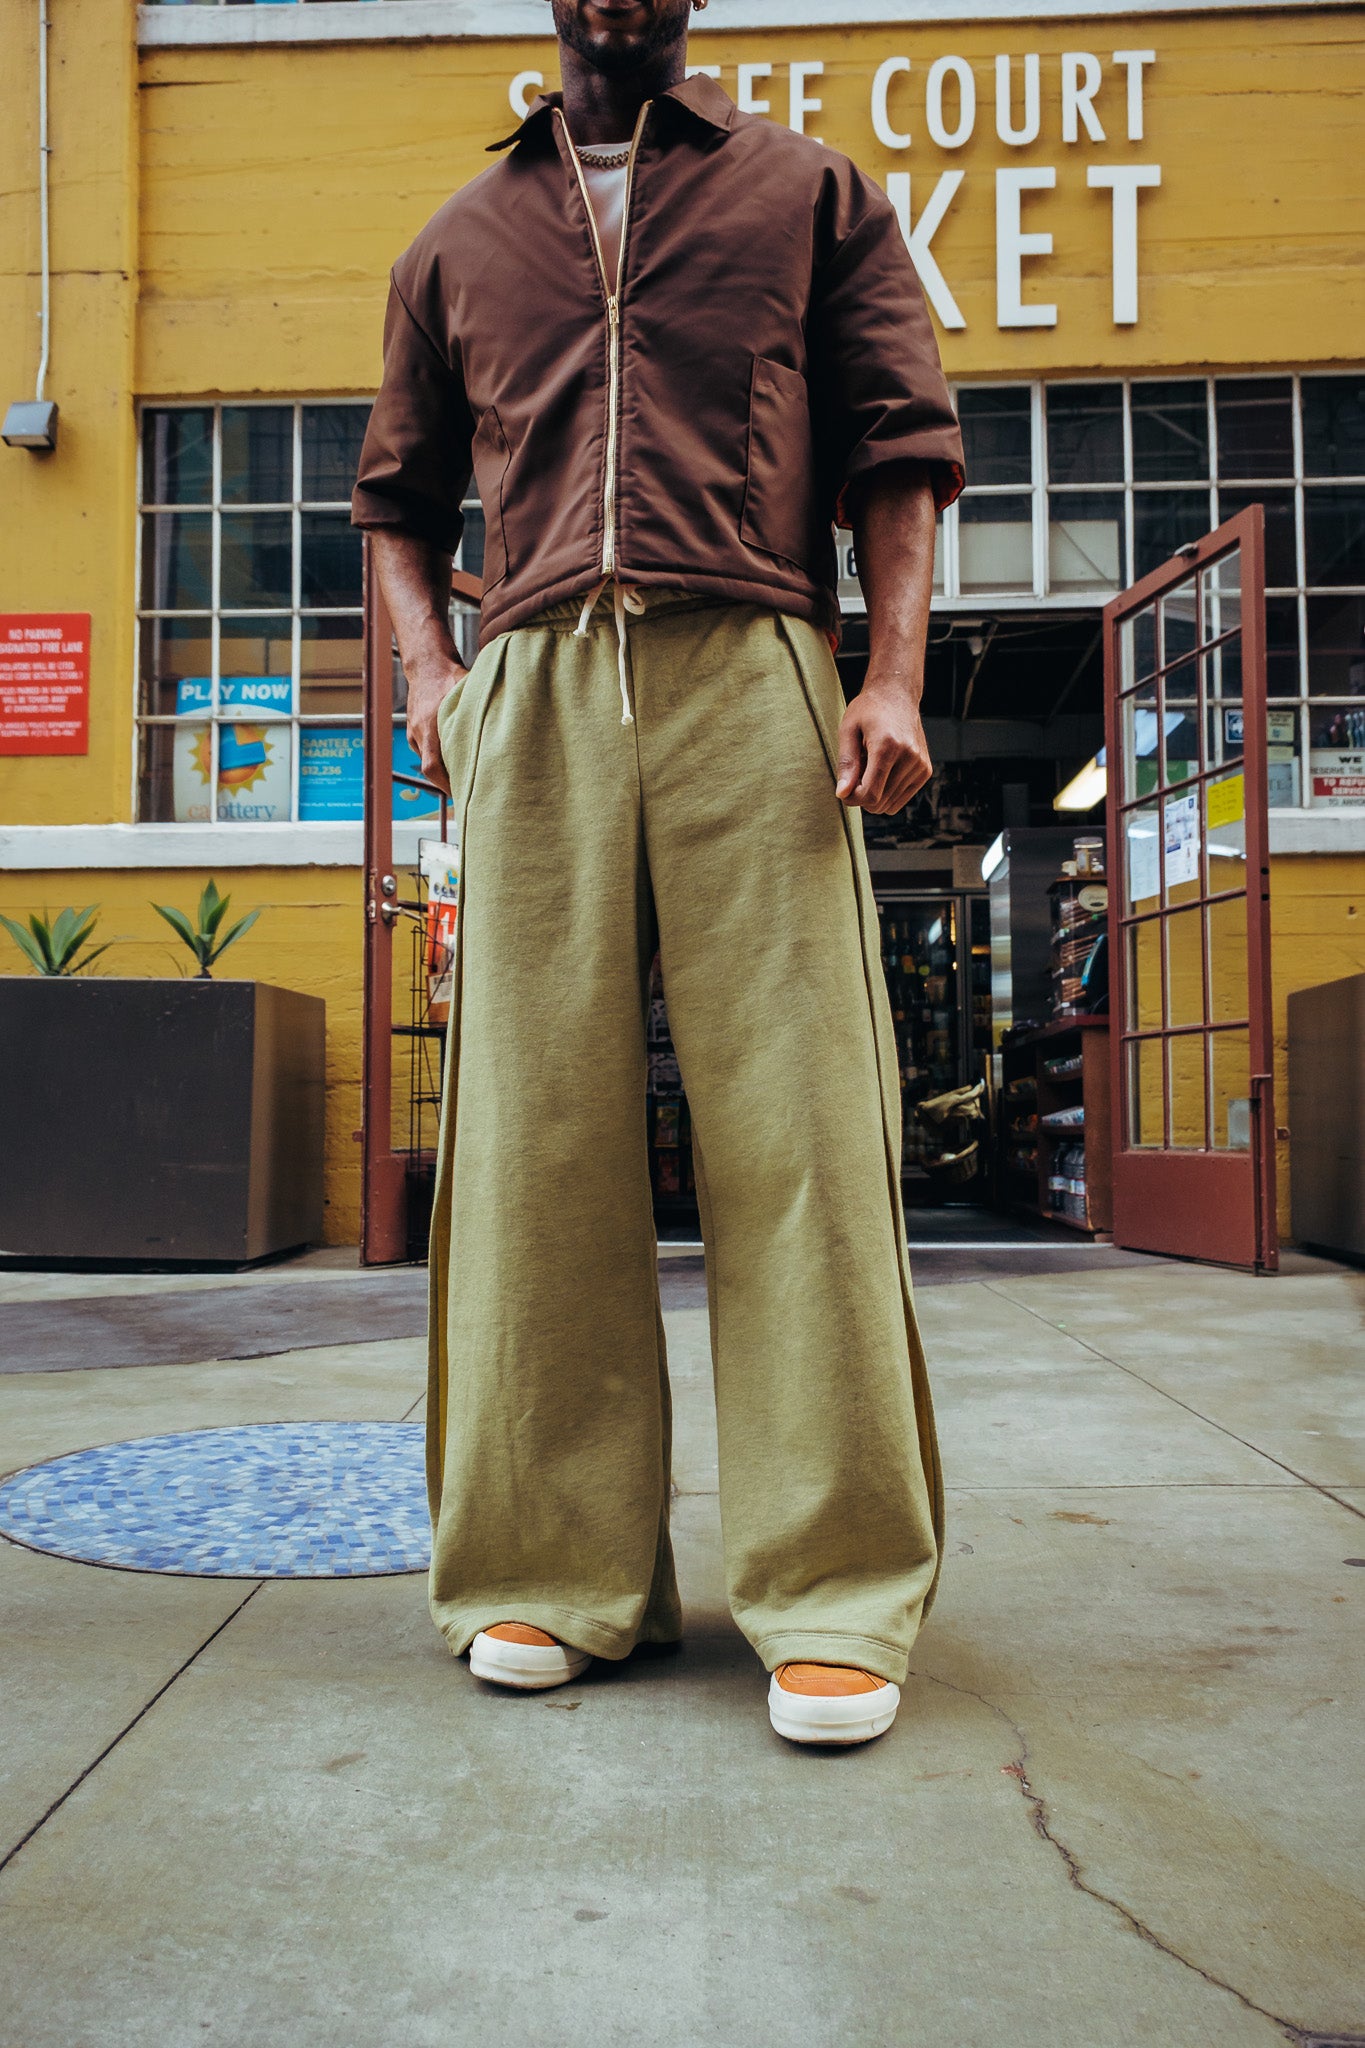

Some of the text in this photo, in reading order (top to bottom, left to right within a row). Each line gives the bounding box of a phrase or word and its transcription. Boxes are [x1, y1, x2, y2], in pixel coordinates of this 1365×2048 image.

[871, 50, 1156, 149] COURT
[24, 628, 63, 640] PARKING
[181, 683, 290, 700] PLY NOW
[302, 738, 350, 748] SANTEE
[302, 748, 353, 758] MARKET
[1323, 778, 1337, 787] TO
[187, 802, 277, 820] caottery
